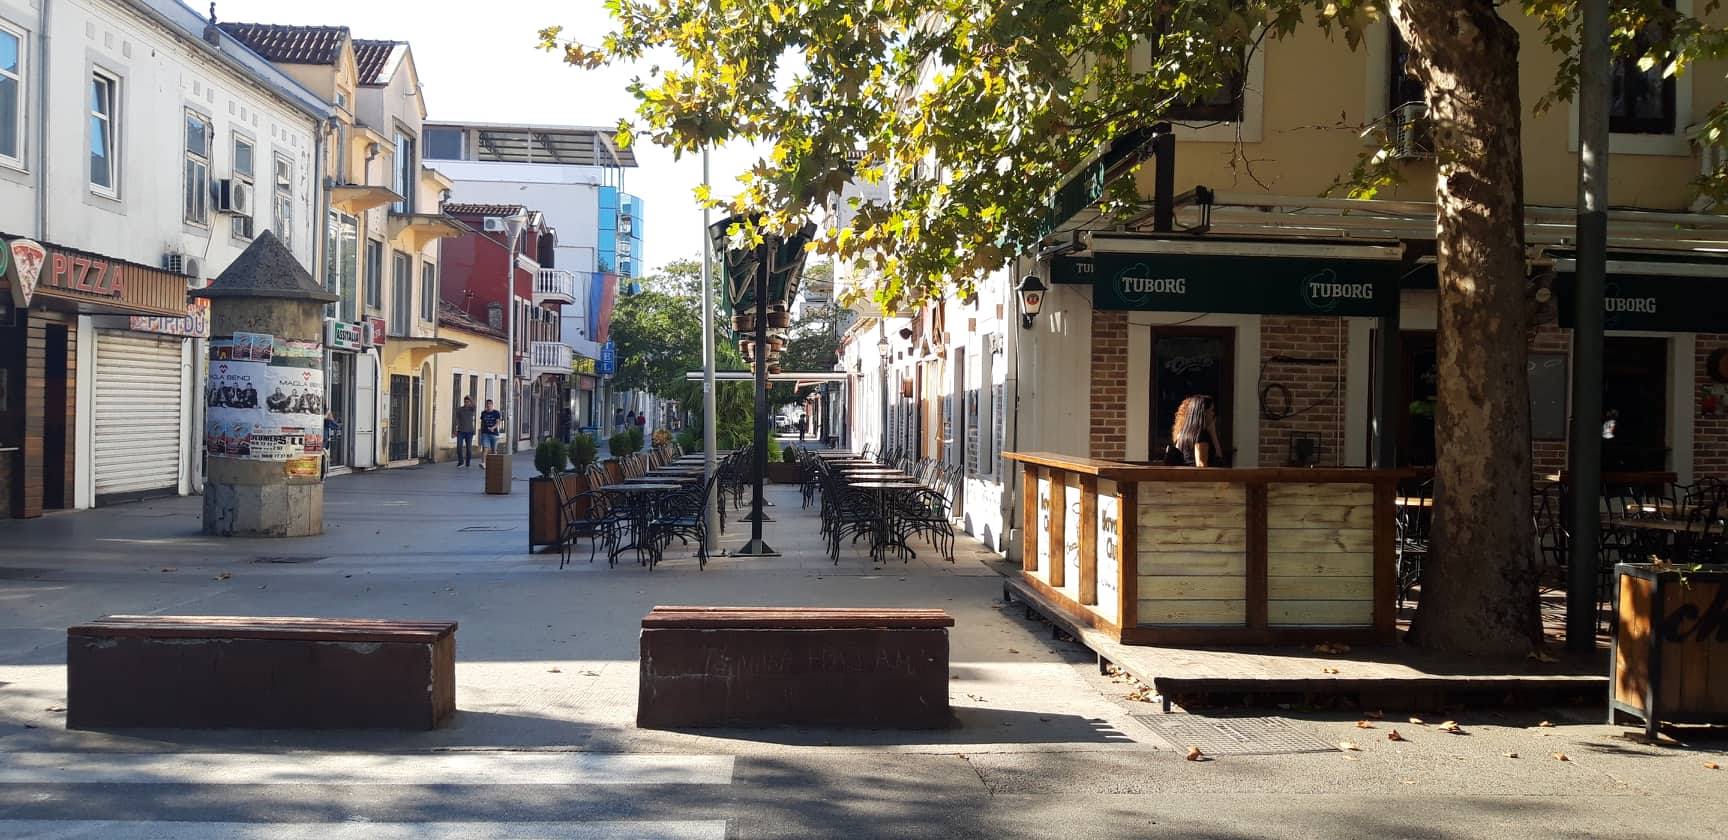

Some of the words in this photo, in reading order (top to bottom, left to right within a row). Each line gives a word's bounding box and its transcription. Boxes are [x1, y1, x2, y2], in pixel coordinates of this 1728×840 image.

[52, 252, 125, 299] PIZZA
[1122, 276, 1186, 294] TUBORG
[1309, 282, 1374, 299] TUBORG
[1604, 297, 1657, 313] UBORG
[335, 328, 360, 343] ASSITALIA
